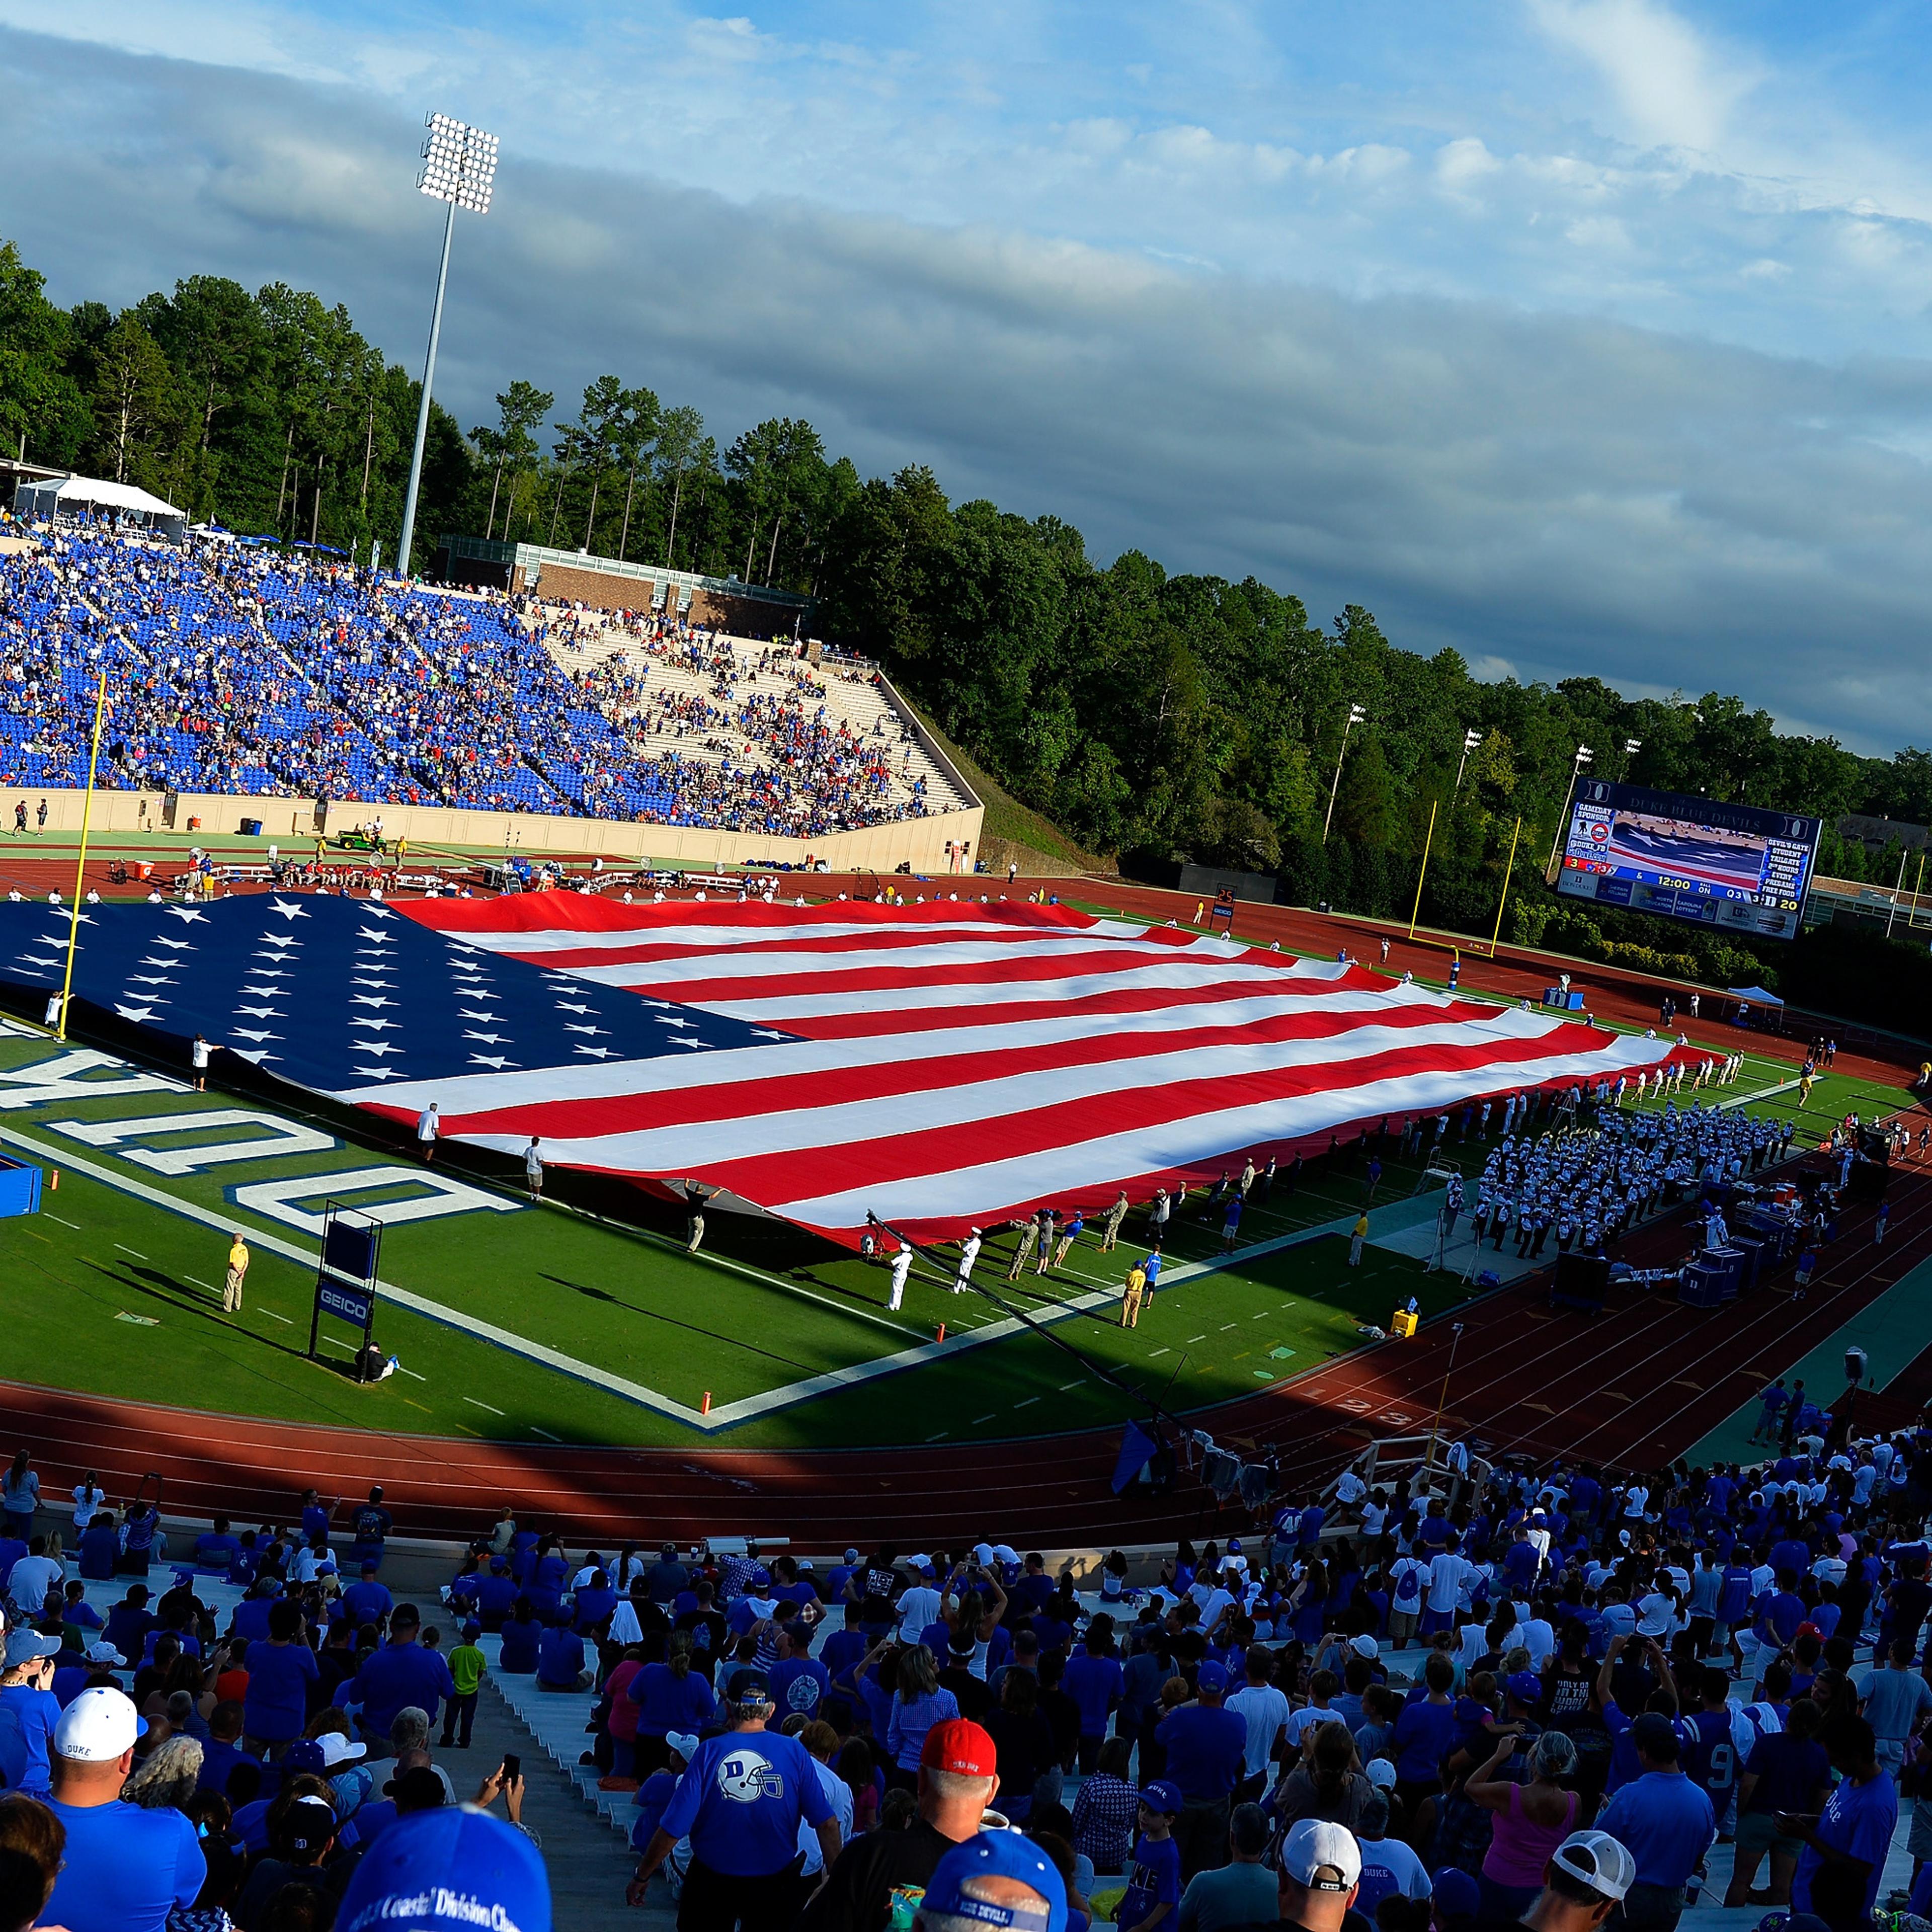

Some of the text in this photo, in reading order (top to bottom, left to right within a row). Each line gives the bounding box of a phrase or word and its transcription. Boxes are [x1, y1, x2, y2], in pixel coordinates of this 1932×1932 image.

[1579, 803, 1613, 815] GAMEDAY
[1630, 797, 1667, 812] DUKE
[1671, 805, 1708, 820] BLUE
[1712, 812, 1760, 830] DEVILS
[1772, 847, 1802, 858] STUDENT
[1570, 859, 1578, 867] 3
[1770, 855, 1801, 866] TAILGATE
[1771, 871, 1792, 880] EVERY
[1778, 865, 1799, 874] HOURS
[1658, 876, 1691, 890] 12:00
[1764, 878, 1796, 890] PREGAME
[1218, 889, 1233, 902] 25
[1698, 887, 1711, 895] ON
[1762, 886, 1795, 898] FREE FOOD
[1675, 906, 1698, 914] LOTTERY
[1677, 900, 1702, 910] CAROLINA
[1780, 899, 1798, 911] 20
[1214, 908, 1232, 916] GEICO
[320, 1289, 367, 1320] GEICO
[1335, 1399, 1372, 1413] 2
[1376, 1412, 1413, 1425] 3
[1557, 1680, 1578, 1688] ONLY
[67, 1744, 92, 1756] DUKE
[723, 1760, 744, 1779] D
[1707, 1744, 1734, 1789] 9
[1148, 1784, 1167, 1800] DUKE
[1364, 1869, 1389, 1878] DUKE
[381, 1886, 436, 1919] Coastal
[435, 1887, 492, 1928] Division
